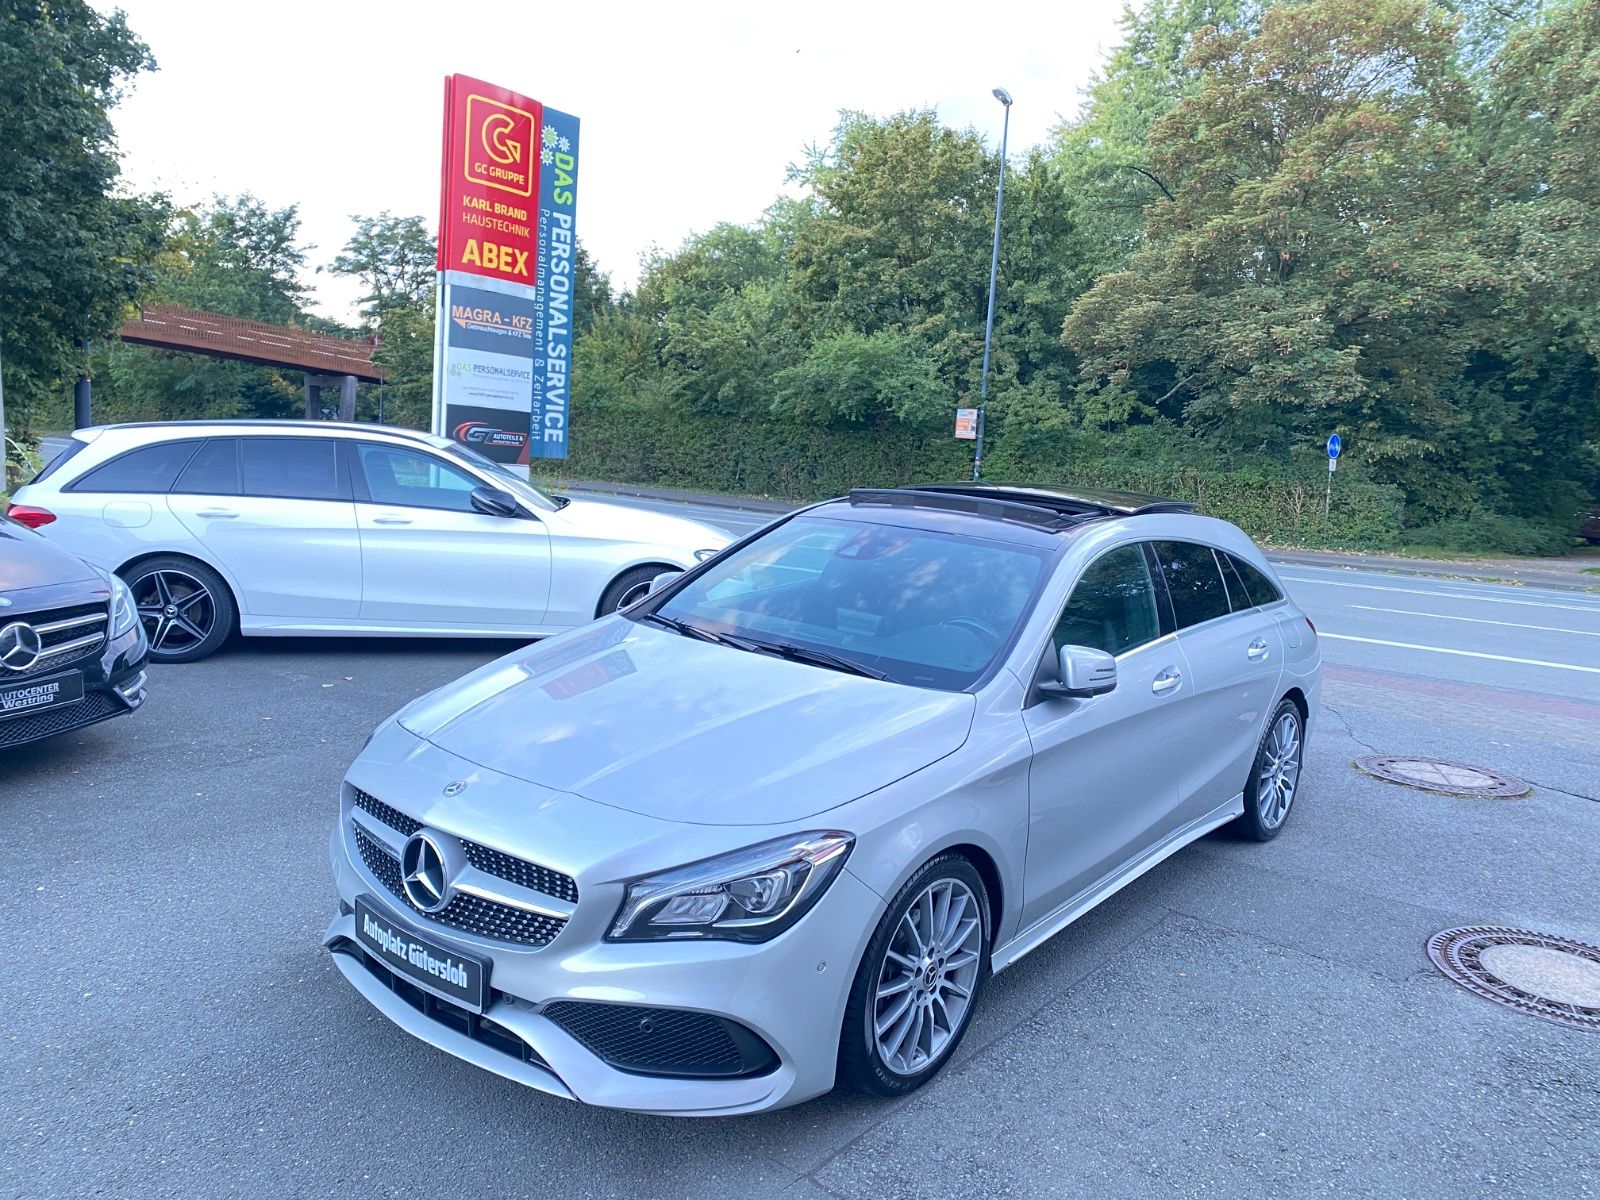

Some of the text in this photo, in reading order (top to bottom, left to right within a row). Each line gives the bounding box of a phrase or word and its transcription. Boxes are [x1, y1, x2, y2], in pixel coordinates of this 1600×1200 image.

[474, 162, 525, 185] GC GRUPPE
[462, 194, 528, 221] KARL BRAND
[462, 211, 530, 238] HAUSTECHNIK
[461, 238, 529, 277] ABEX
[544, 152, 575, 443] DAS PERSONALSERVICE
[452, 304, 502, 324] MAGRA
[512, 315, 533, 330] KFZ
[531, 208, 551, 441] Personalmanagement & Zeitarbeit
[456, 361, 472, 372] DAS
[473, 364, 531, 380] PERSONALSERVICE
[493, 433, 519, 441] AUTOTEILE
[3, 693, 54, 709] Westring
[363, 913, 407, 960] Autoplatz
[408, 943, 468, 989] Gütersloh
